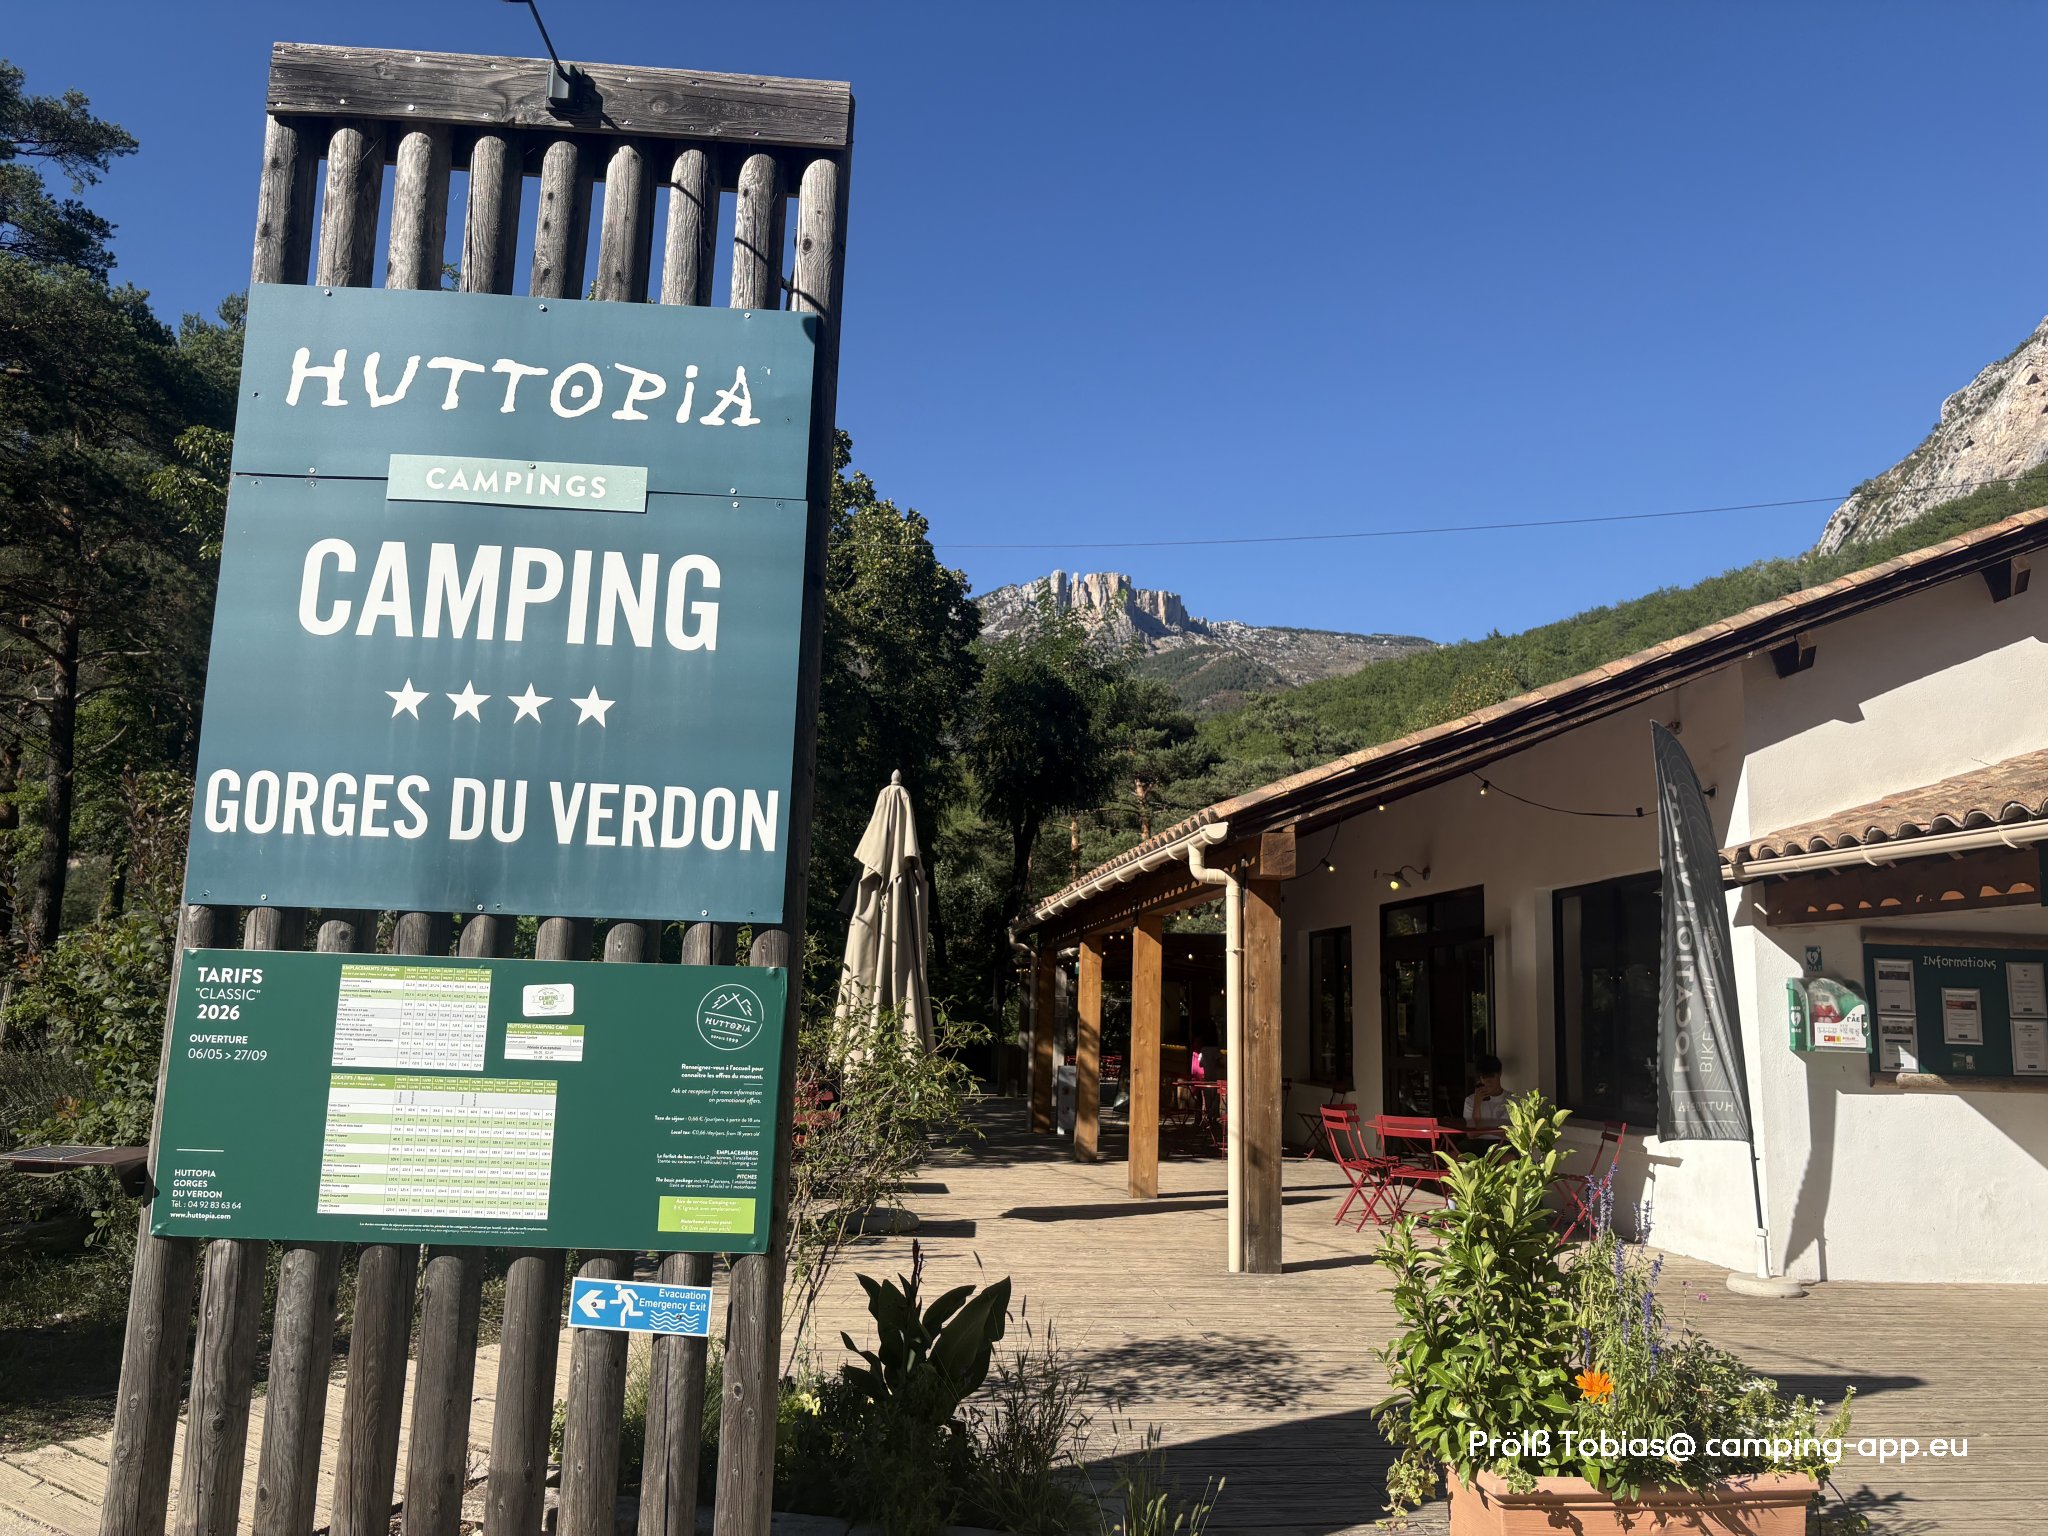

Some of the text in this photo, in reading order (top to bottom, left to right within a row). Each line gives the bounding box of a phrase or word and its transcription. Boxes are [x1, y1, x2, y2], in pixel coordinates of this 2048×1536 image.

[285, 347, 761, 426] HUTTOPIA
[426, 467, 607, 499] CAMPINGS
[299, 538, 721, 652] CAMPING
[204, 768, 779, 852] GORGES DU VERDON
[198, 966, 264, 984] TARIFS
[196, 988, 260, 1000] "CLASSIC"
[196, 1004, 240, 1020] 2026
[705, 1016, 750, 1032] HUTTOPIA
[190, 1034, 248, 1044] OUVERTURE
[188, 1048, 222, 1060] 06/05
[234, 1050, 267, 1060] 27/09
[175, 1169, 216, 1177] HUTTOPIA
[170, 1211, 231, 1221] www.huttopia.com
[658, 1288, 706, 1300] Evacuation
[638, 1298, 706, 1312] Emergency Exit
